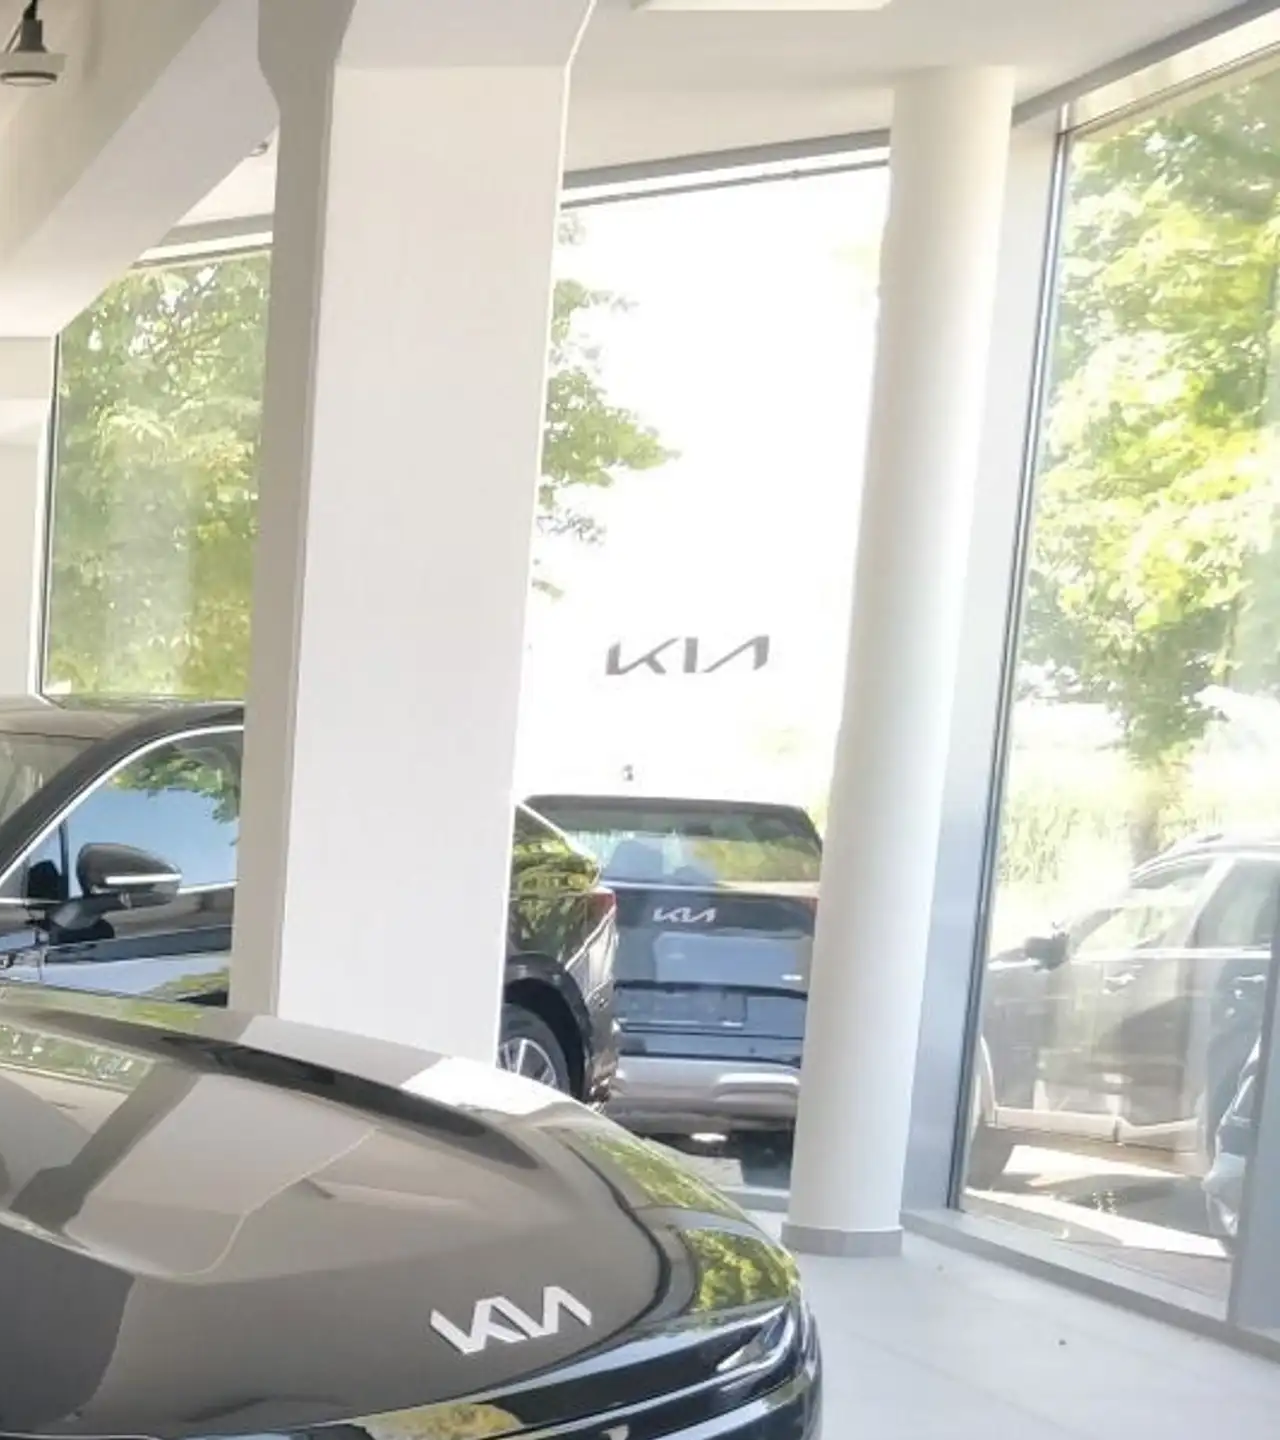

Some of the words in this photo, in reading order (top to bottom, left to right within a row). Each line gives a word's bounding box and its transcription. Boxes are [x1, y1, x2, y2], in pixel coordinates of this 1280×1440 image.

[605, 635, 770, 675] KIA
[653, 907, 717, 922] KIA
[430, 1286, 593, 1354] KIA
